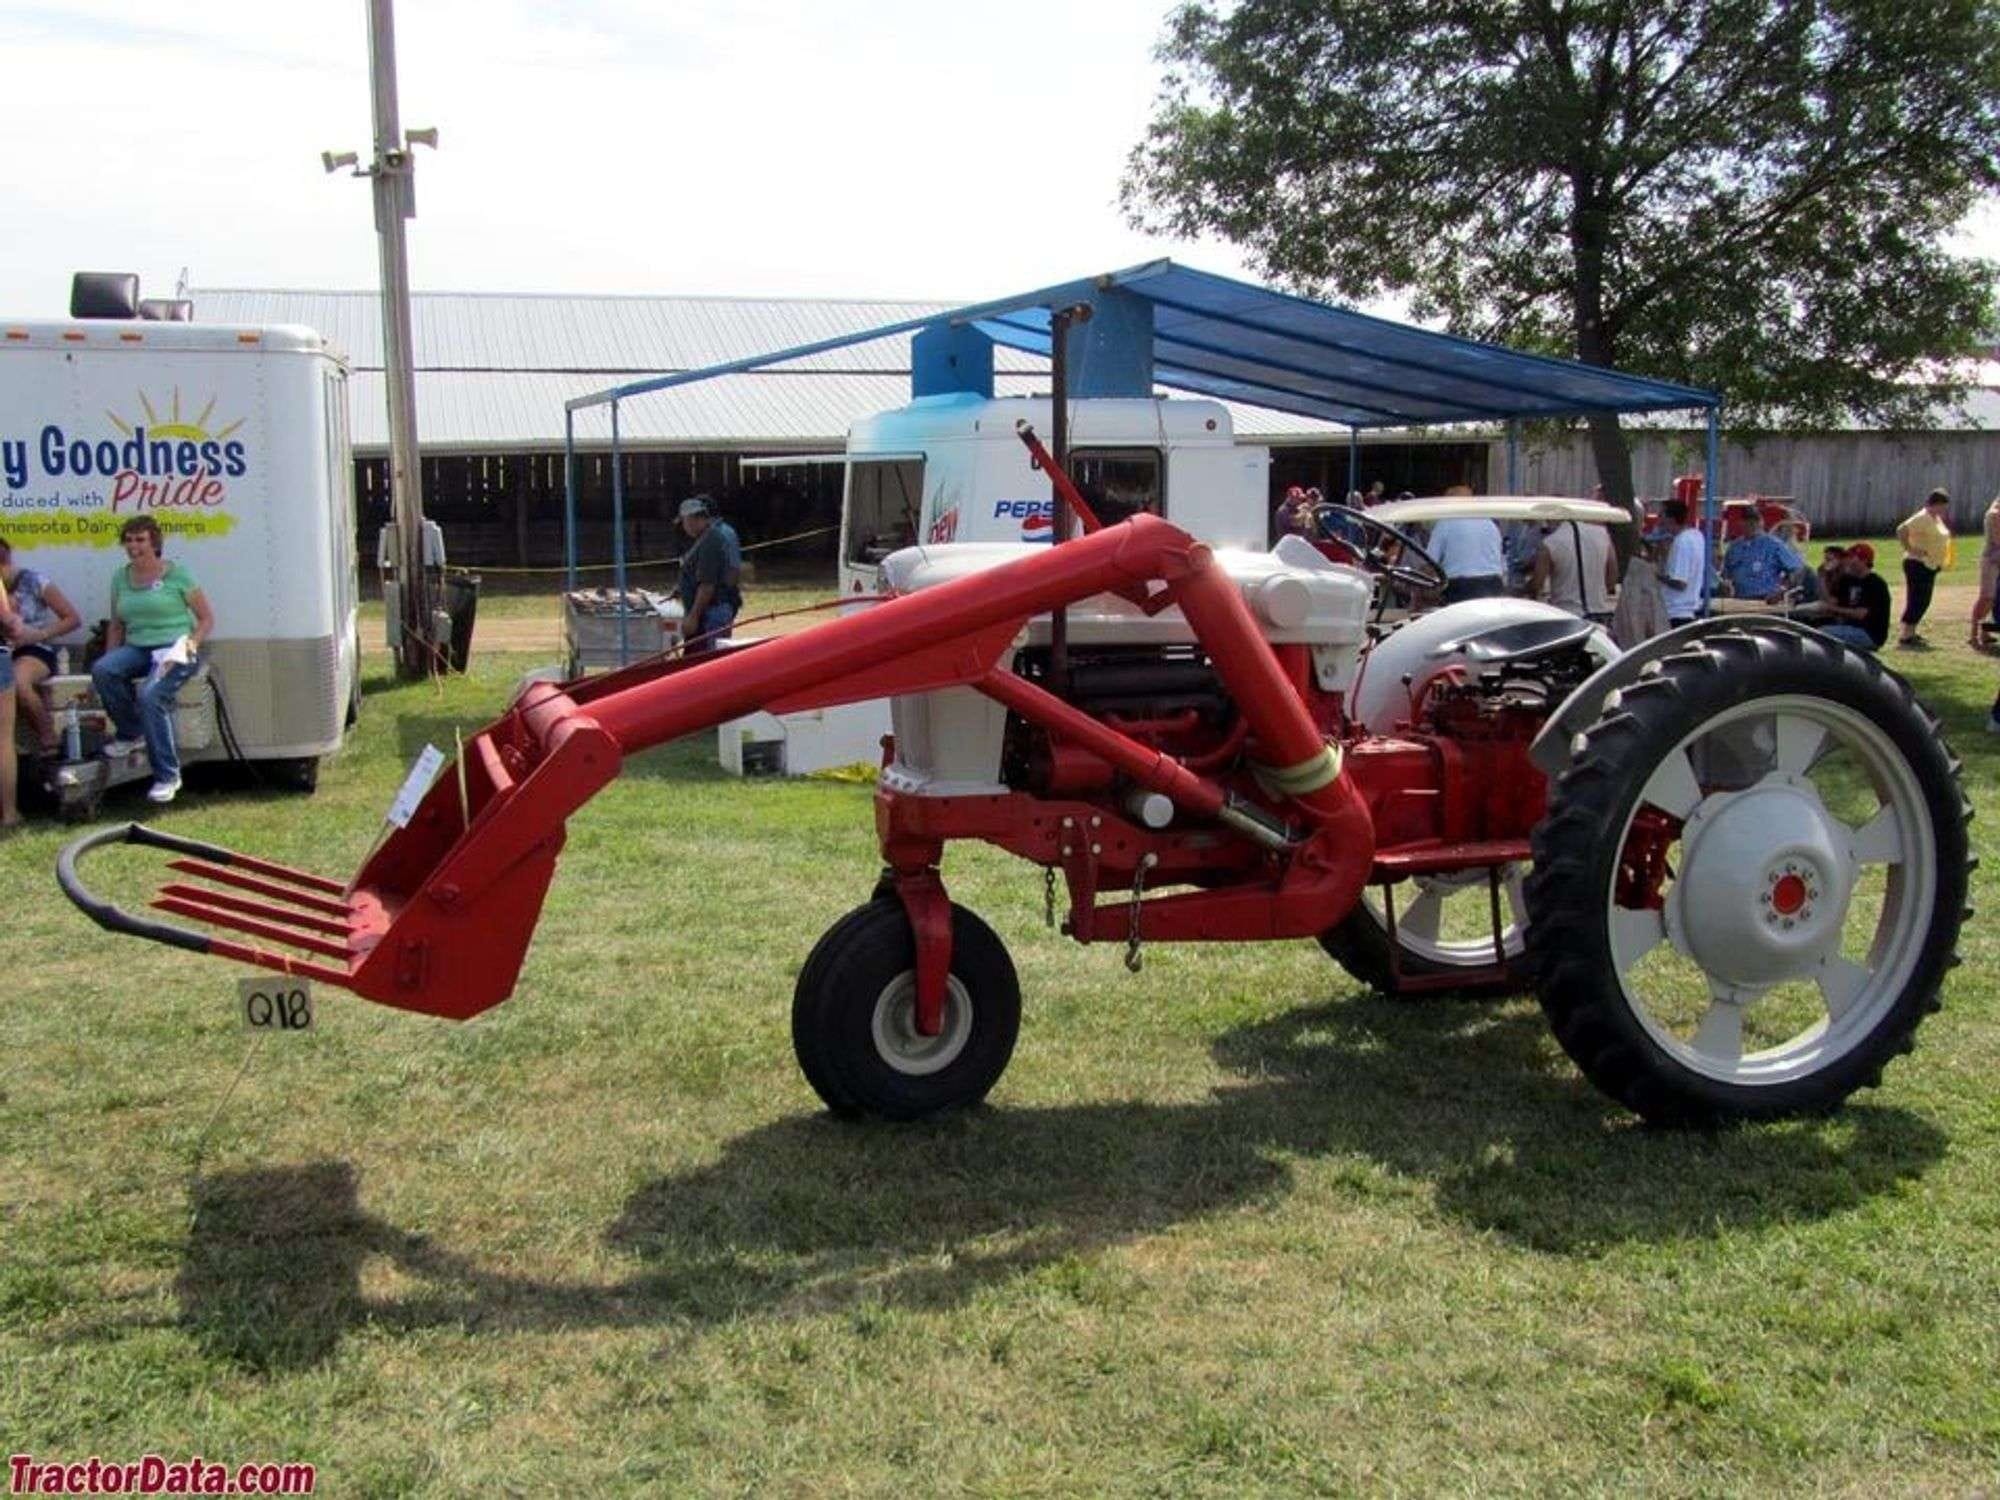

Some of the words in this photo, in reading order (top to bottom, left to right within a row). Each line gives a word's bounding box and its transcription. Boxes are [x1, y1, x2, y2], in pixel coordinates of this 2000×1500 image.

[40, 425, 247, 477] Goodness
[2, 491, 60, 508] duced
[66, 492, 104, 508] with
[111, 466, 225, 513] Pride
[0, 518, 70, 534] nnesota
[993, 501, 1055, 519] PEPS
[247, 990, 311, 1029] Q18
